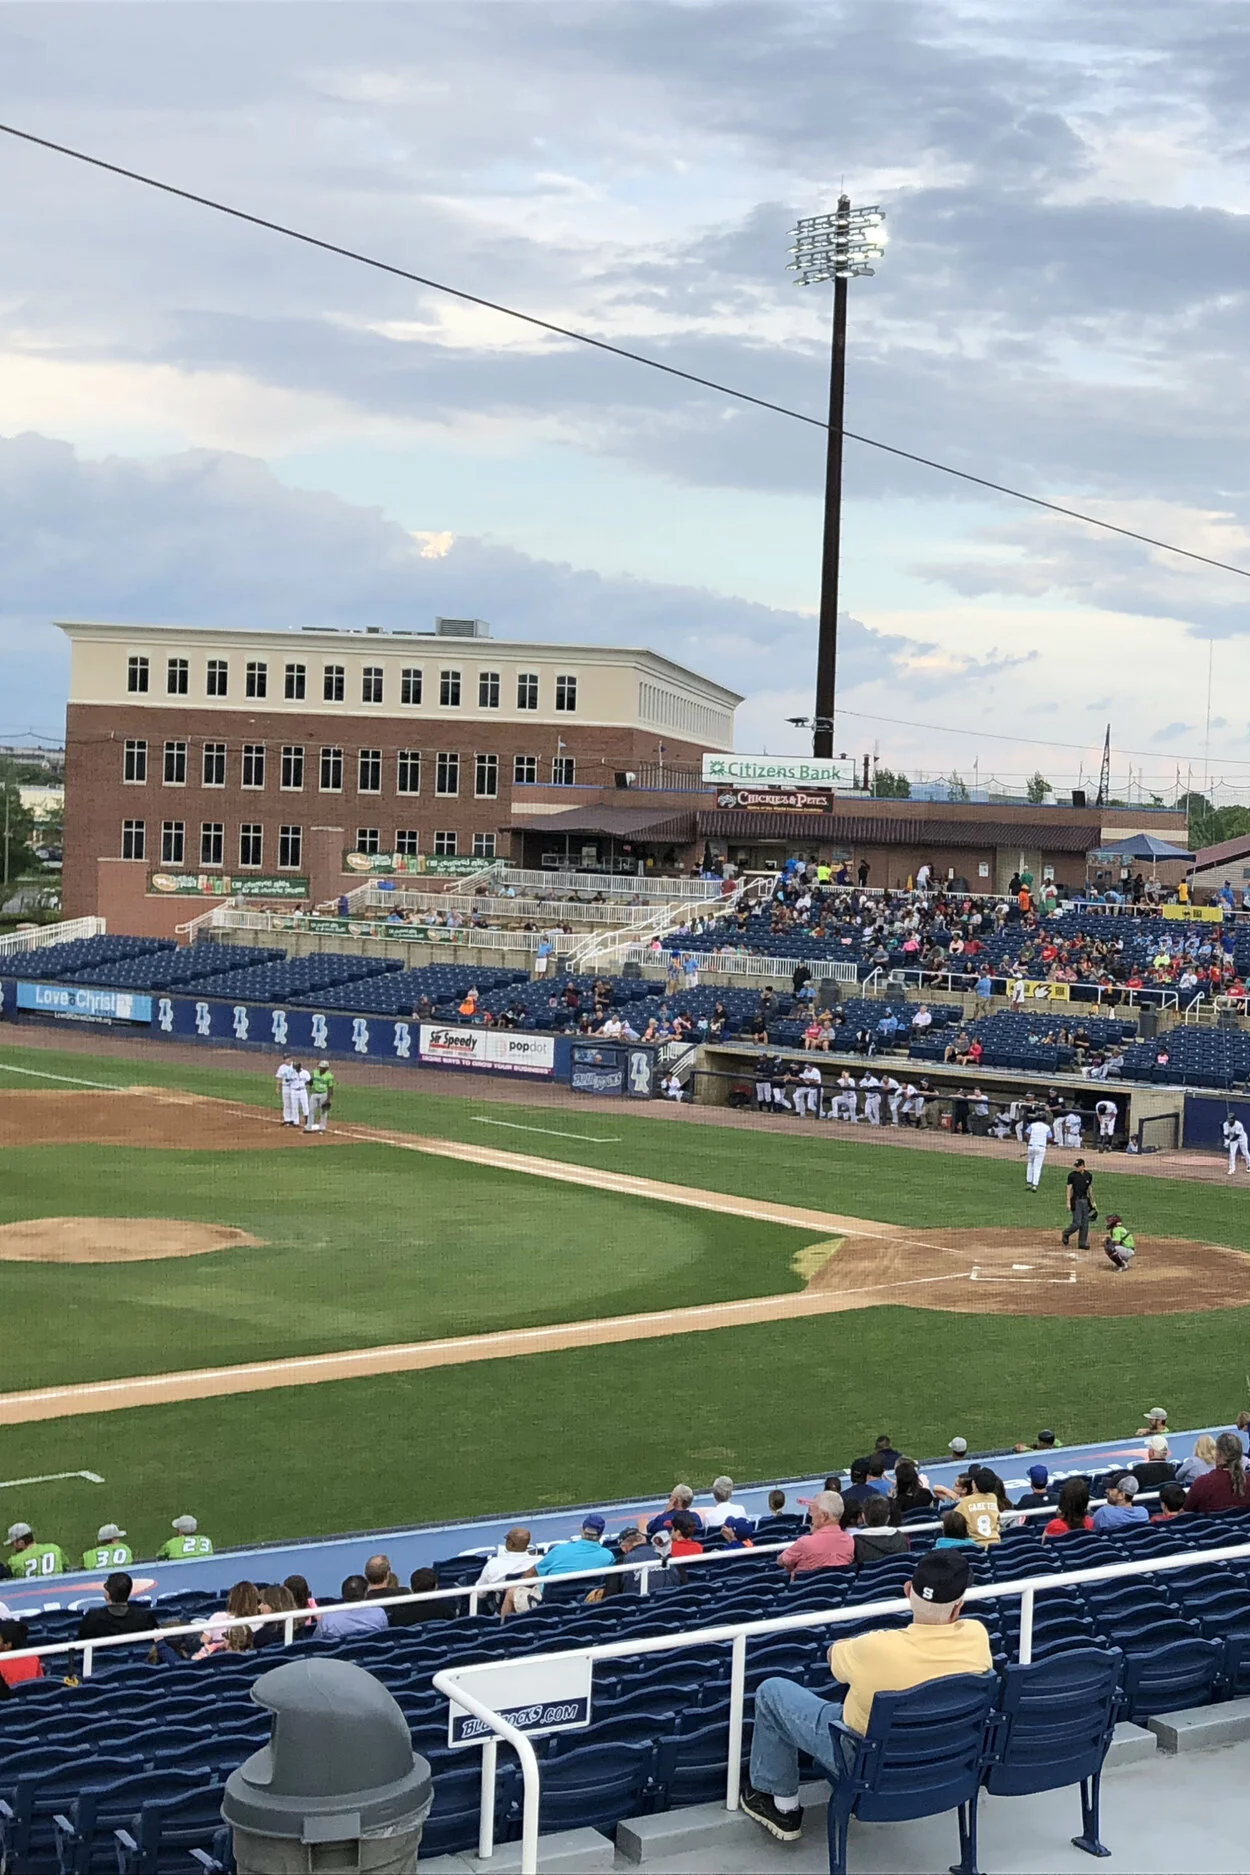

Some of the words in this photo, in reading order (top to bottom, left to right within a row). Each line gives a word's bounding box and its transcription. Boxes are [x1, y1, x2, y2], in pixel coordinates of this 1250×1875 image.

[728, 762, 794, 779] Citizens
[800, 765, 840, 780] Bank
[789, 796, 795, 805] &
[36, 985, 69, 1005] Love
[76, 989, 116, 1012] Christ
[430, 1031, 441, 1043] Sir
[443, 1032, 478, 1051] Speedy
[509, 1041, 547, 1053] popdot
[977, 1515, 991, 1537] 8
[182, 1537, 211, 1553] 23
[24, 1551, 55, 1577] 20
[96, 1548, 127, 1569] 30
[922, 1587, 934, 1600] S
